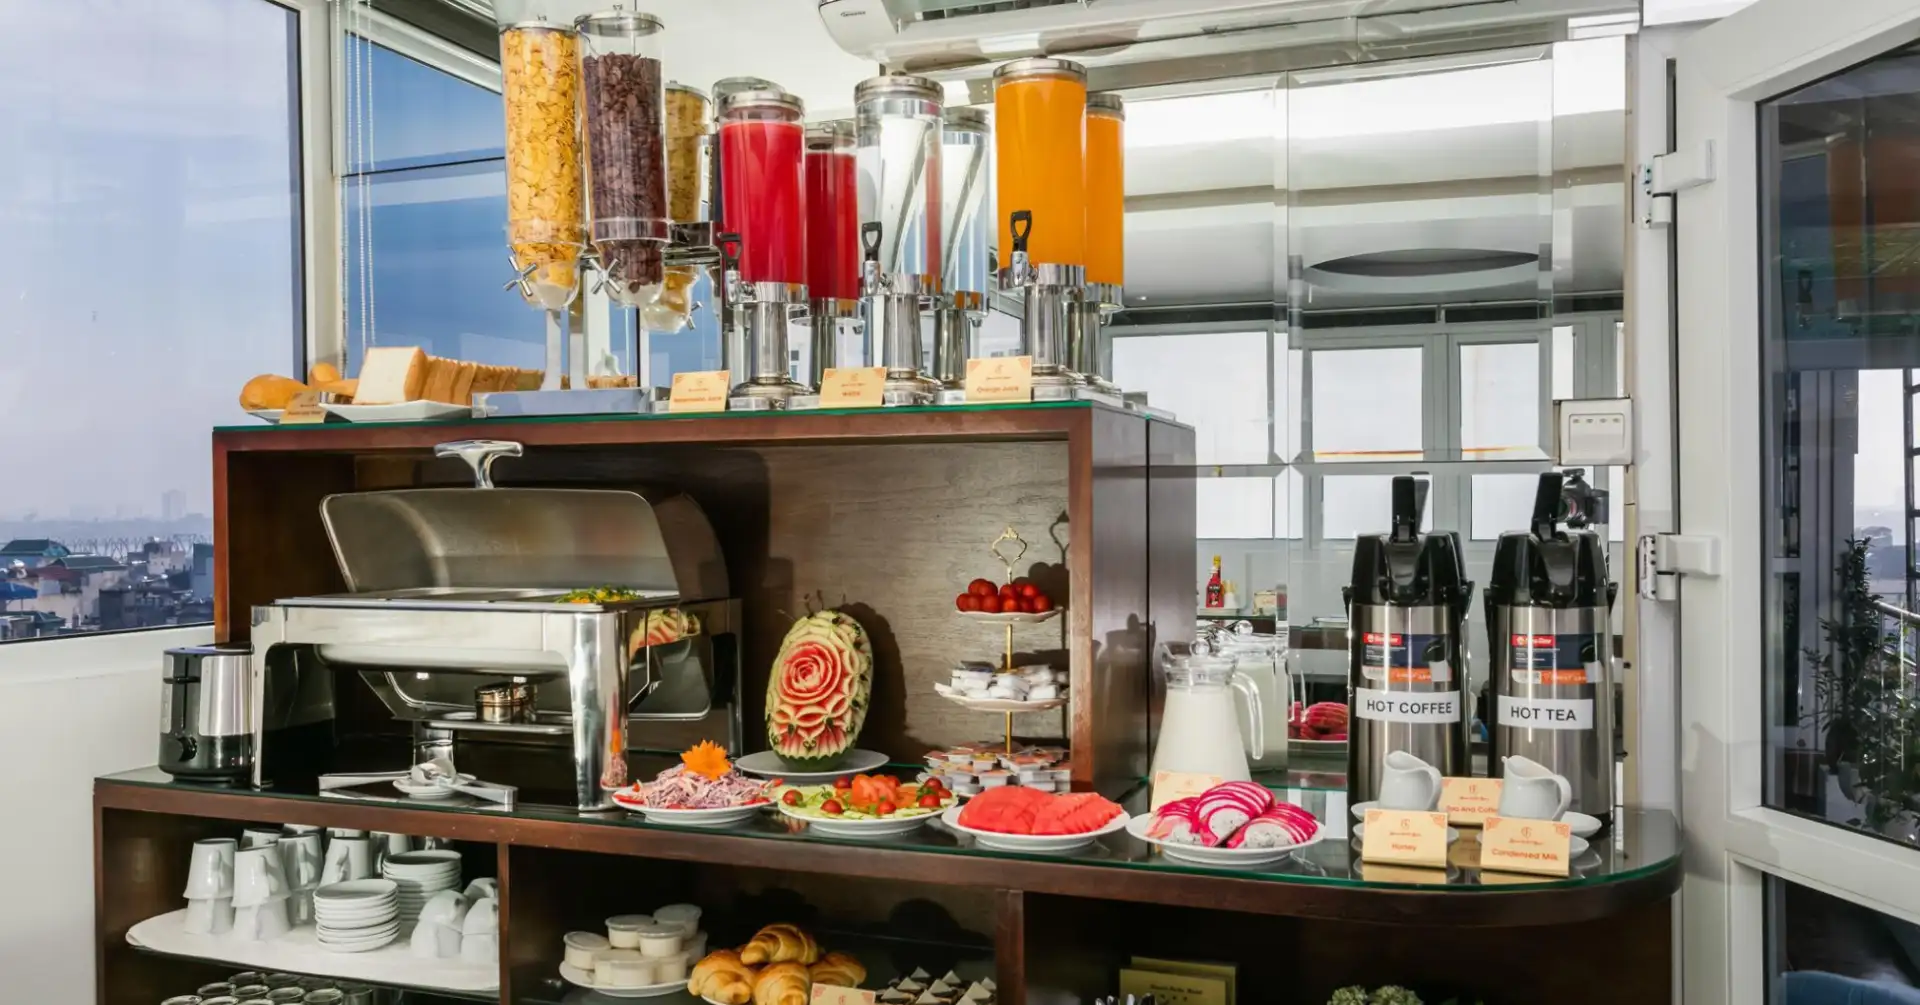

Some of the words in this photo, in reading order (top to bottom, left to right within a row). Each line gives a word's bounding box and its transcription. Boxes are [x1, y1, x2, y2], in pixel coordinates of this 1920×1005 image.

[1366, 699, 1394, 713] HOT
[1399, 701, 1453, 715] COFFEE
[1510, 705, 1540, 720] HOT
[1545, 708, 1577, 721] TEA
[1491, 848, 1540, 860] Condensed
